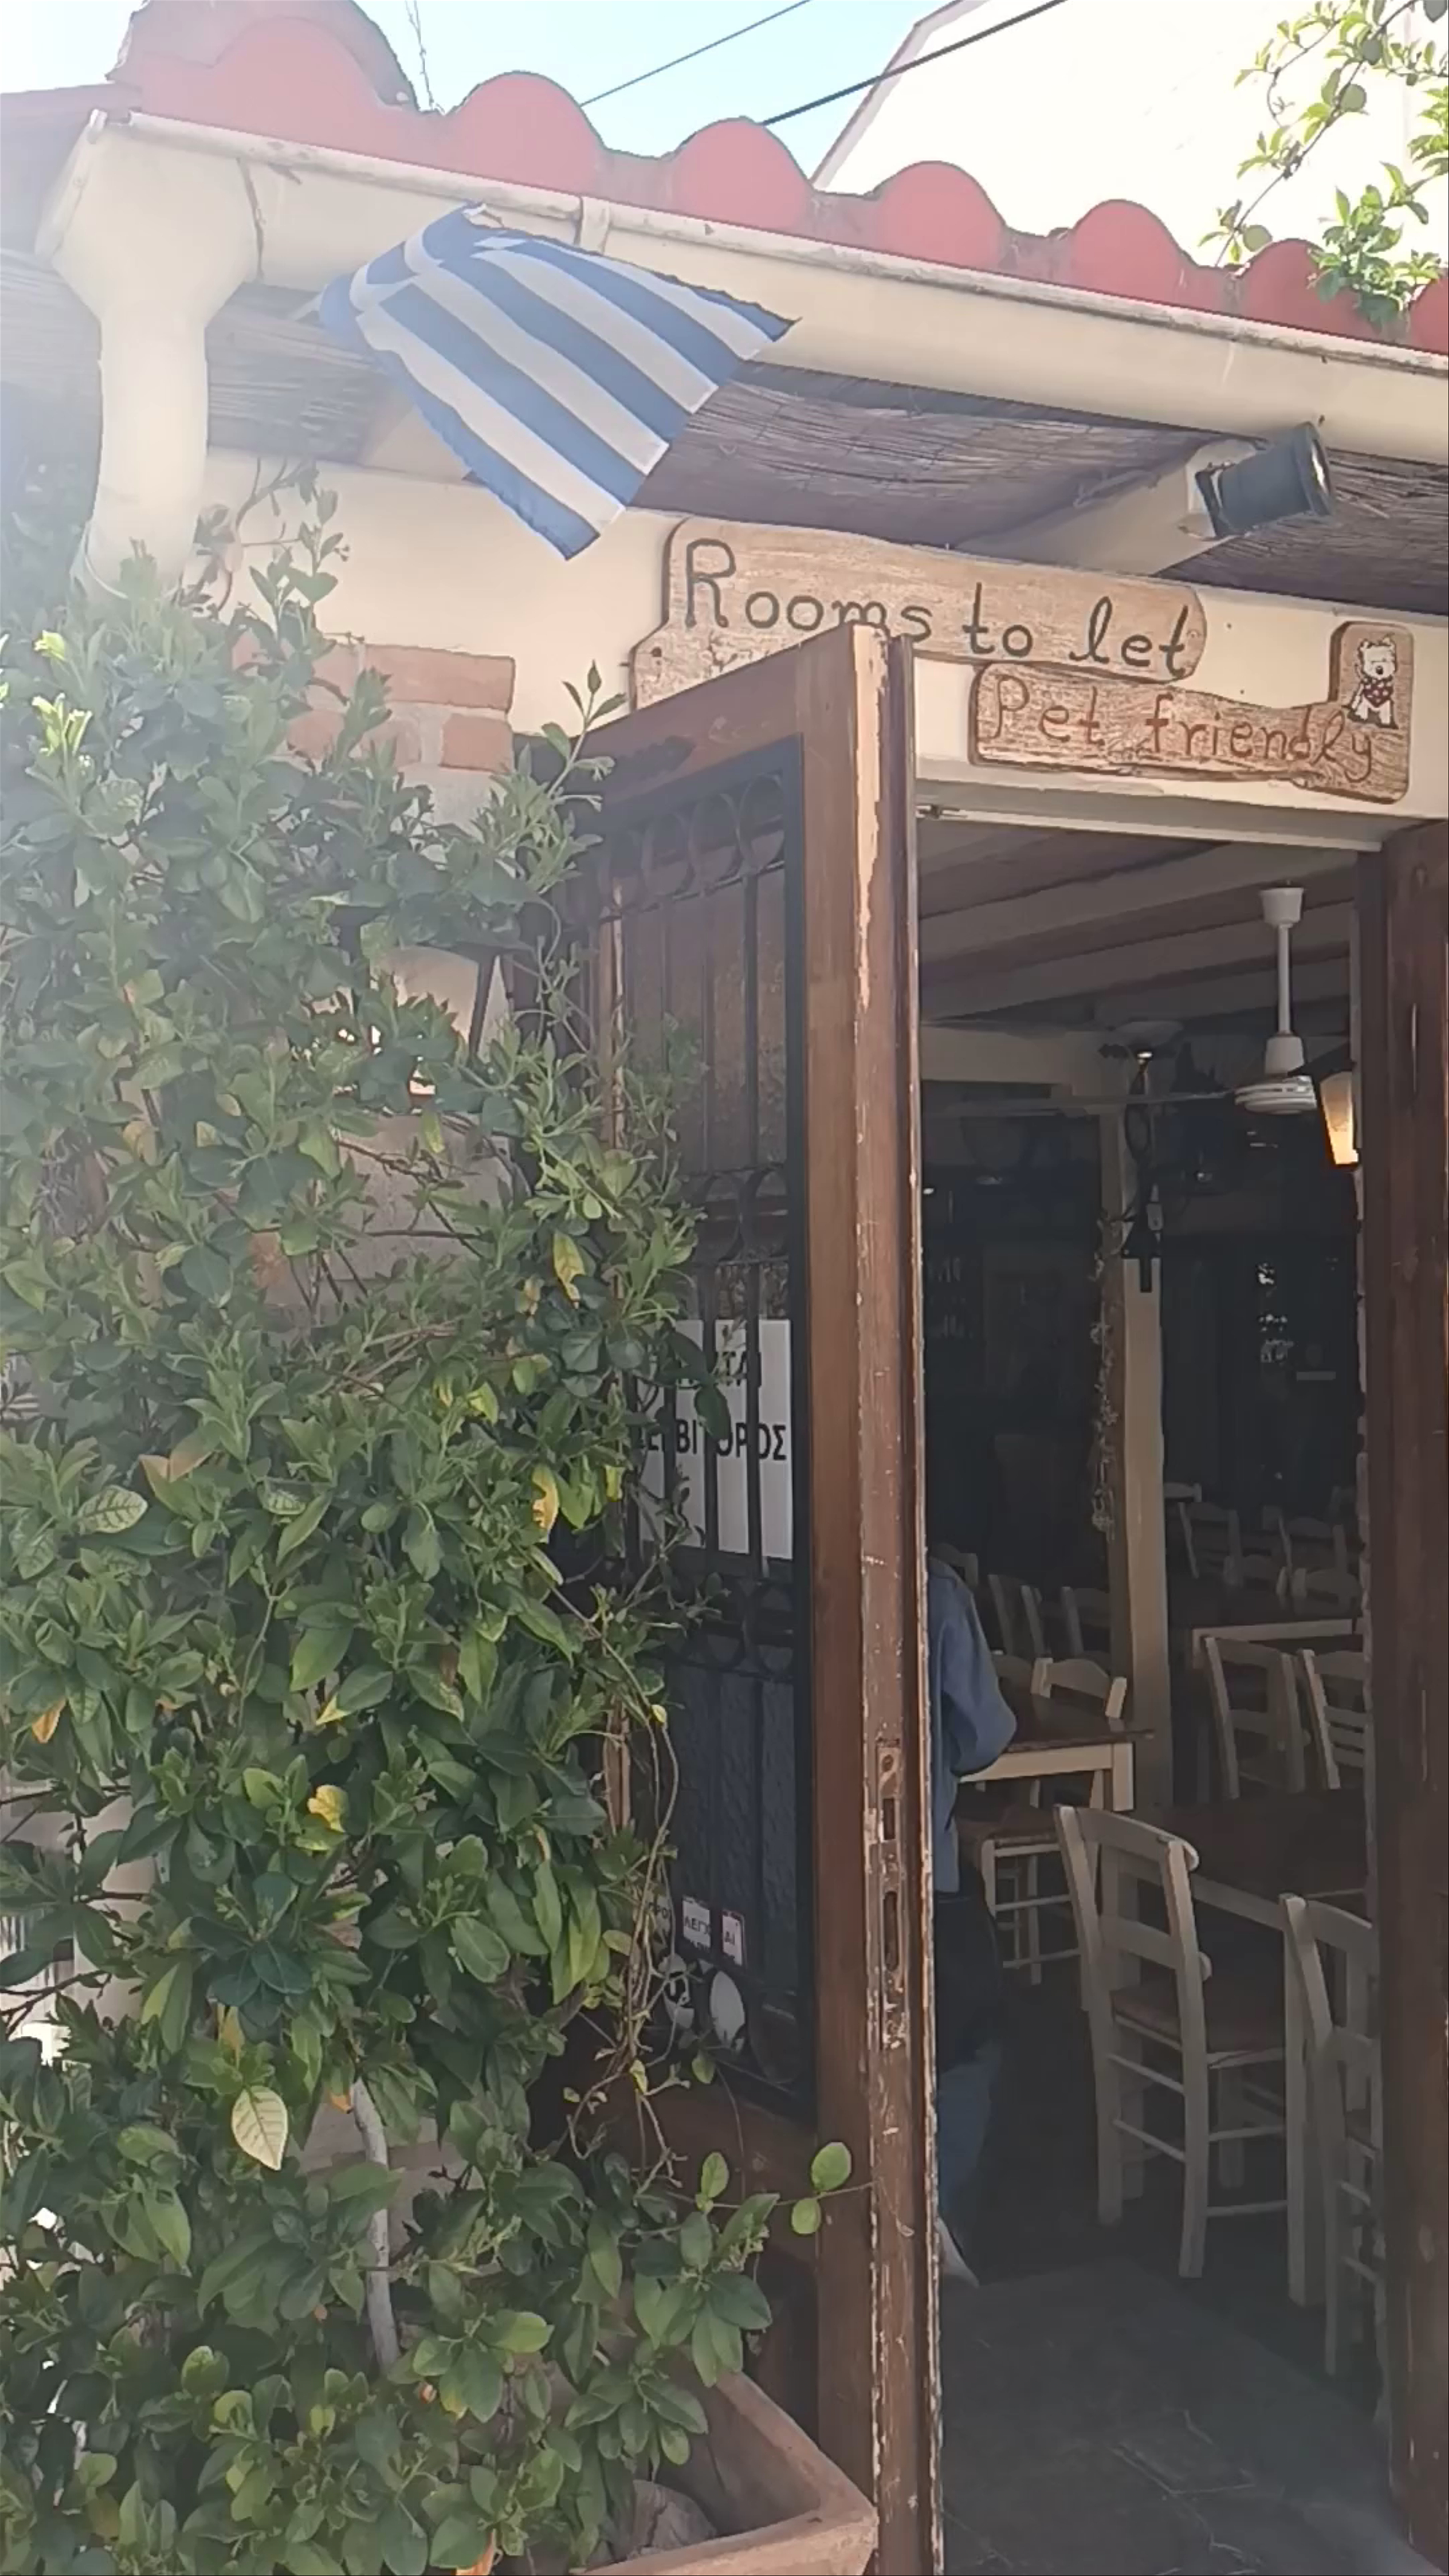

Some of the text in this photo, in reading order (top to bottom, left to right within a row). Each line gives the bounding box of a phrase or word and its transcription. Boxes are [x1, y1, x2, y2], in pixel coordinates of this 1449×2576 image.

[685, 537, 1189, 678] Rooms to let
[983, 674, 1372, 783] Pet friendly
